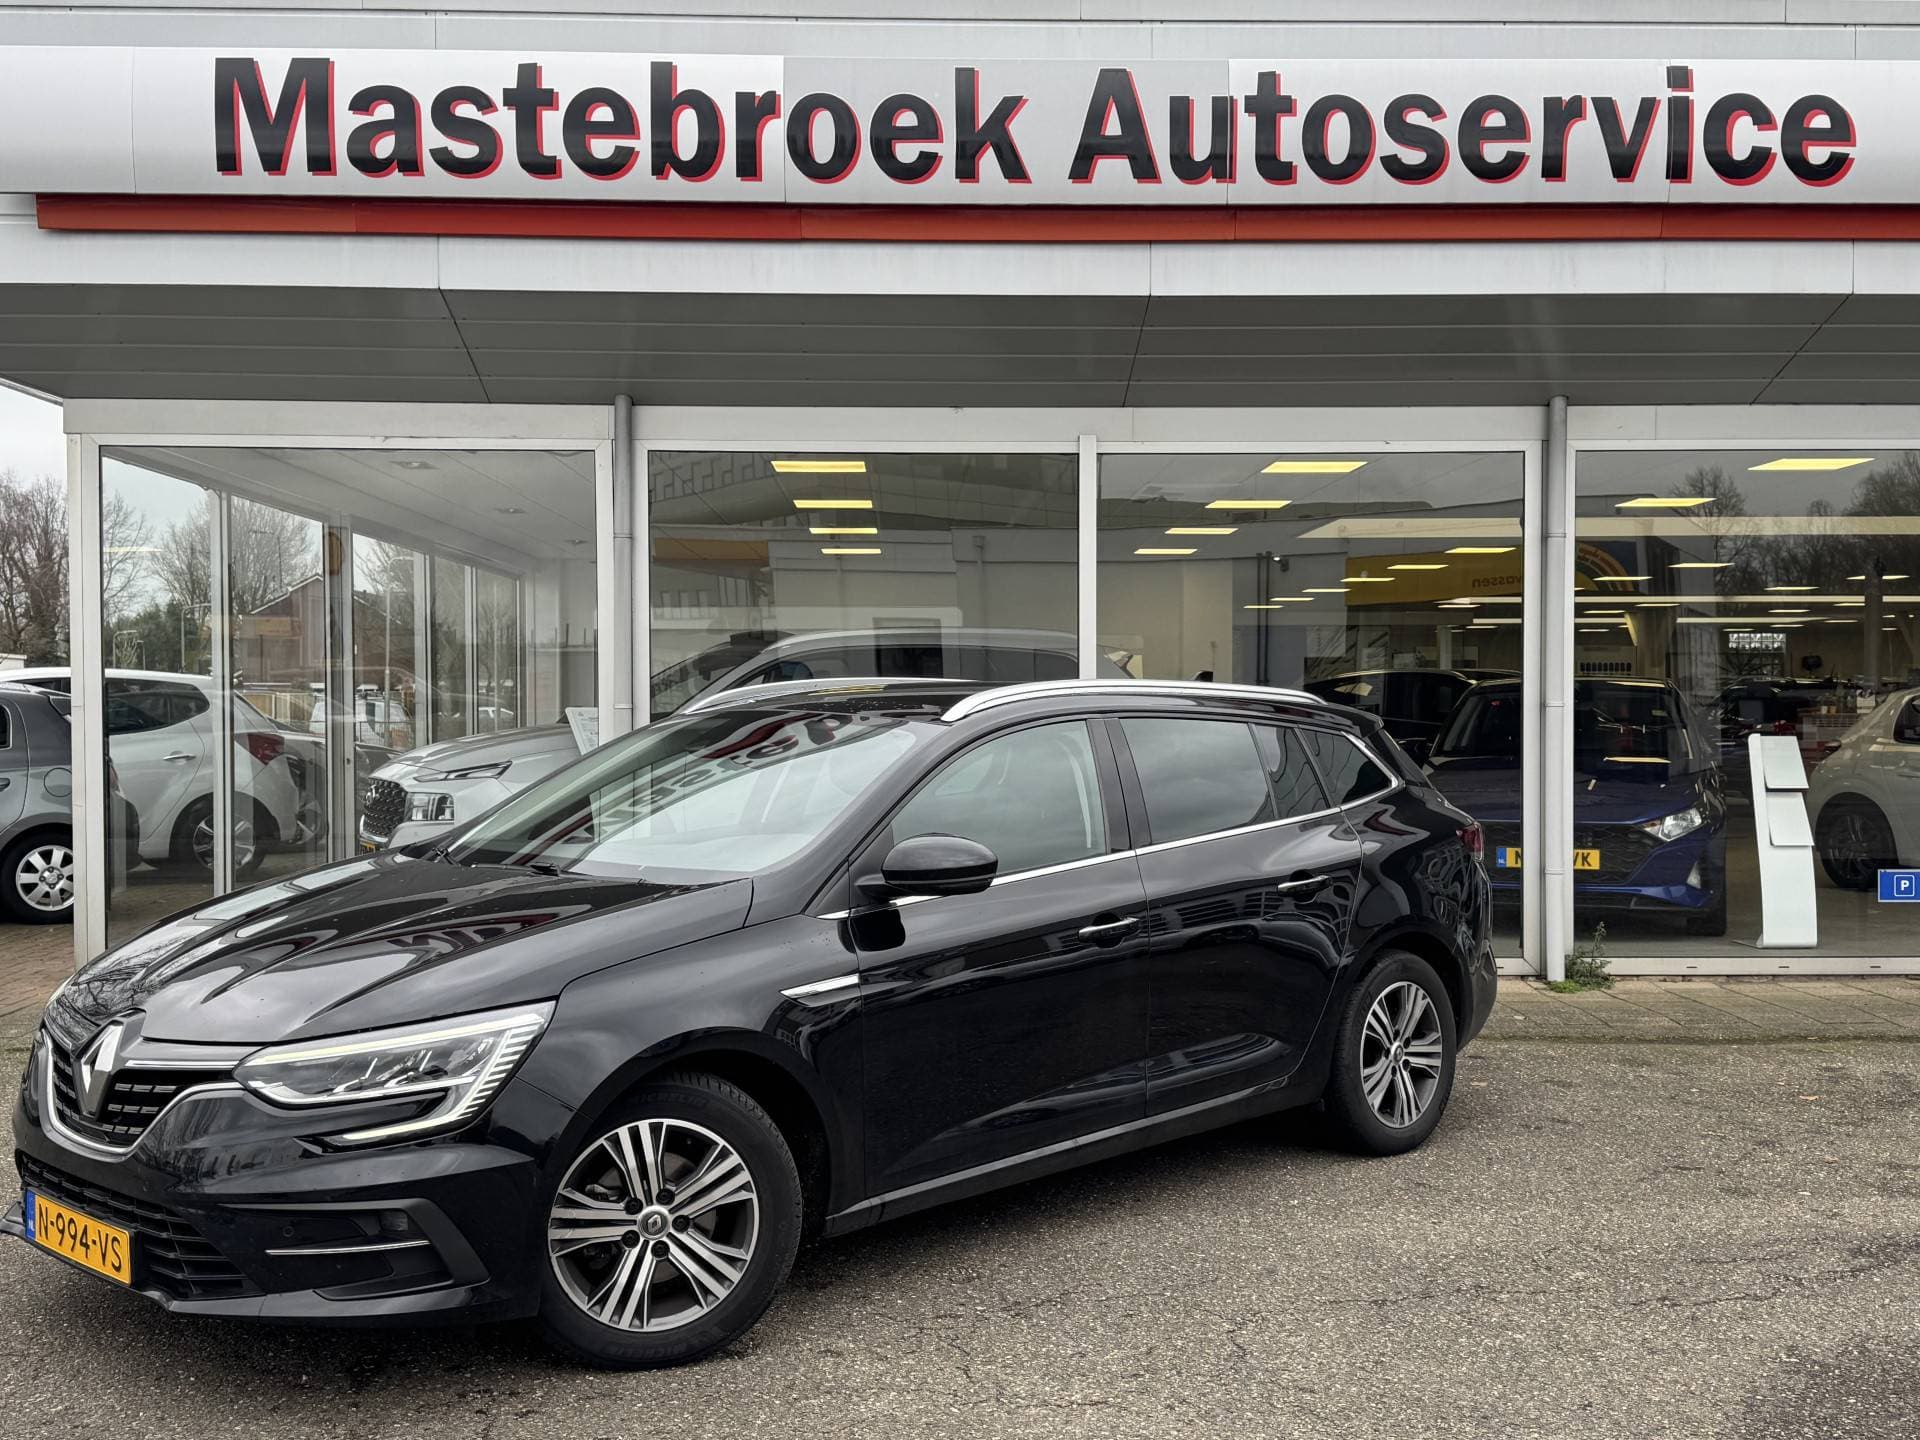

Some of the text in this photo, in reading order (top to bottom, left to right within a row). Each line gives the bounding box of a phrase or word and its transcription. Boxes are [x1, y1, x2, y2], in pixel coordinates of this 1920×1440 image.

[214, 57, 1857, 188] Mastebroek Autoservice
[1901, 879, 1910, 891] P
[39, 1203, 122, 1273] N-994-VS
